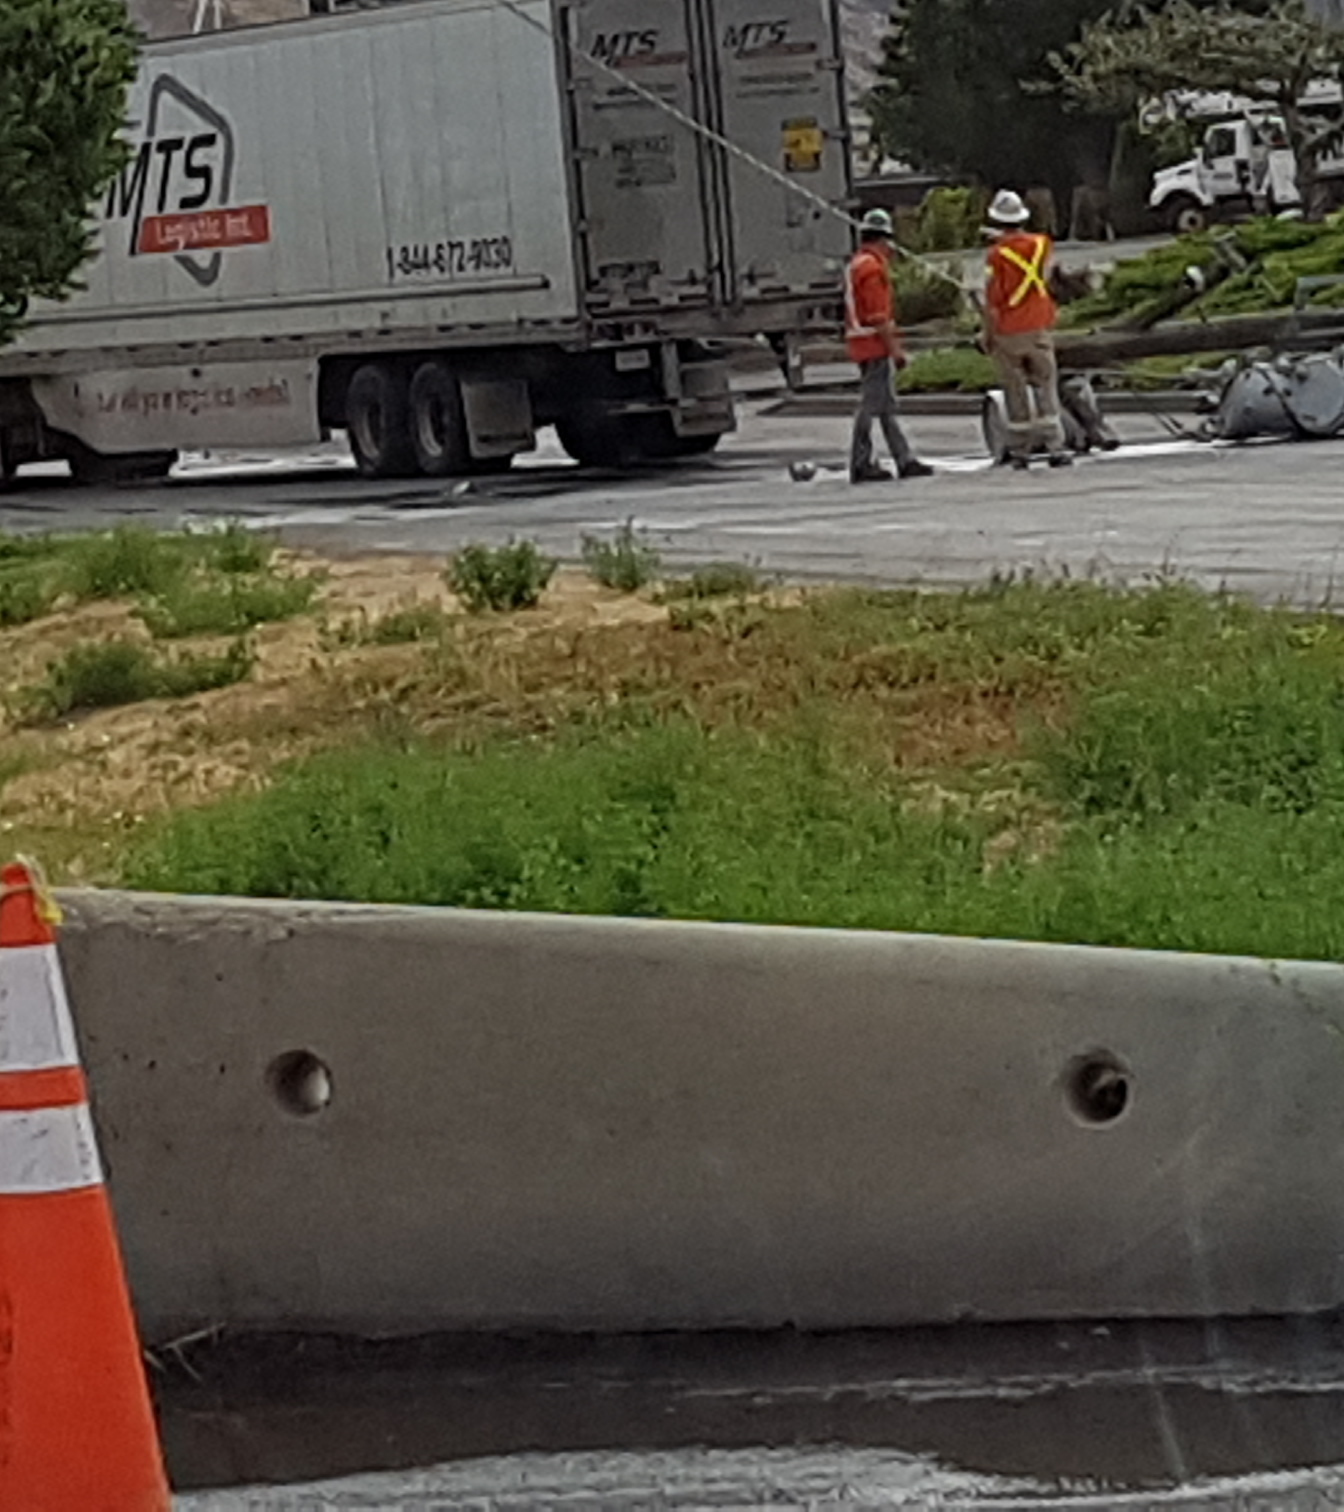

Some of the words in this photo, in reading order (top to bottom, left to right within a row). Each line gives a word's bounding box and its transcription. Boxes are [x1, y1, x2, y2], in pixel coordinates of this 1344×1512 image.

[590, 29, 659, 67] MTS
[722, 20, 790, 59] MTS
[106, 133, 217, 256] MTS
